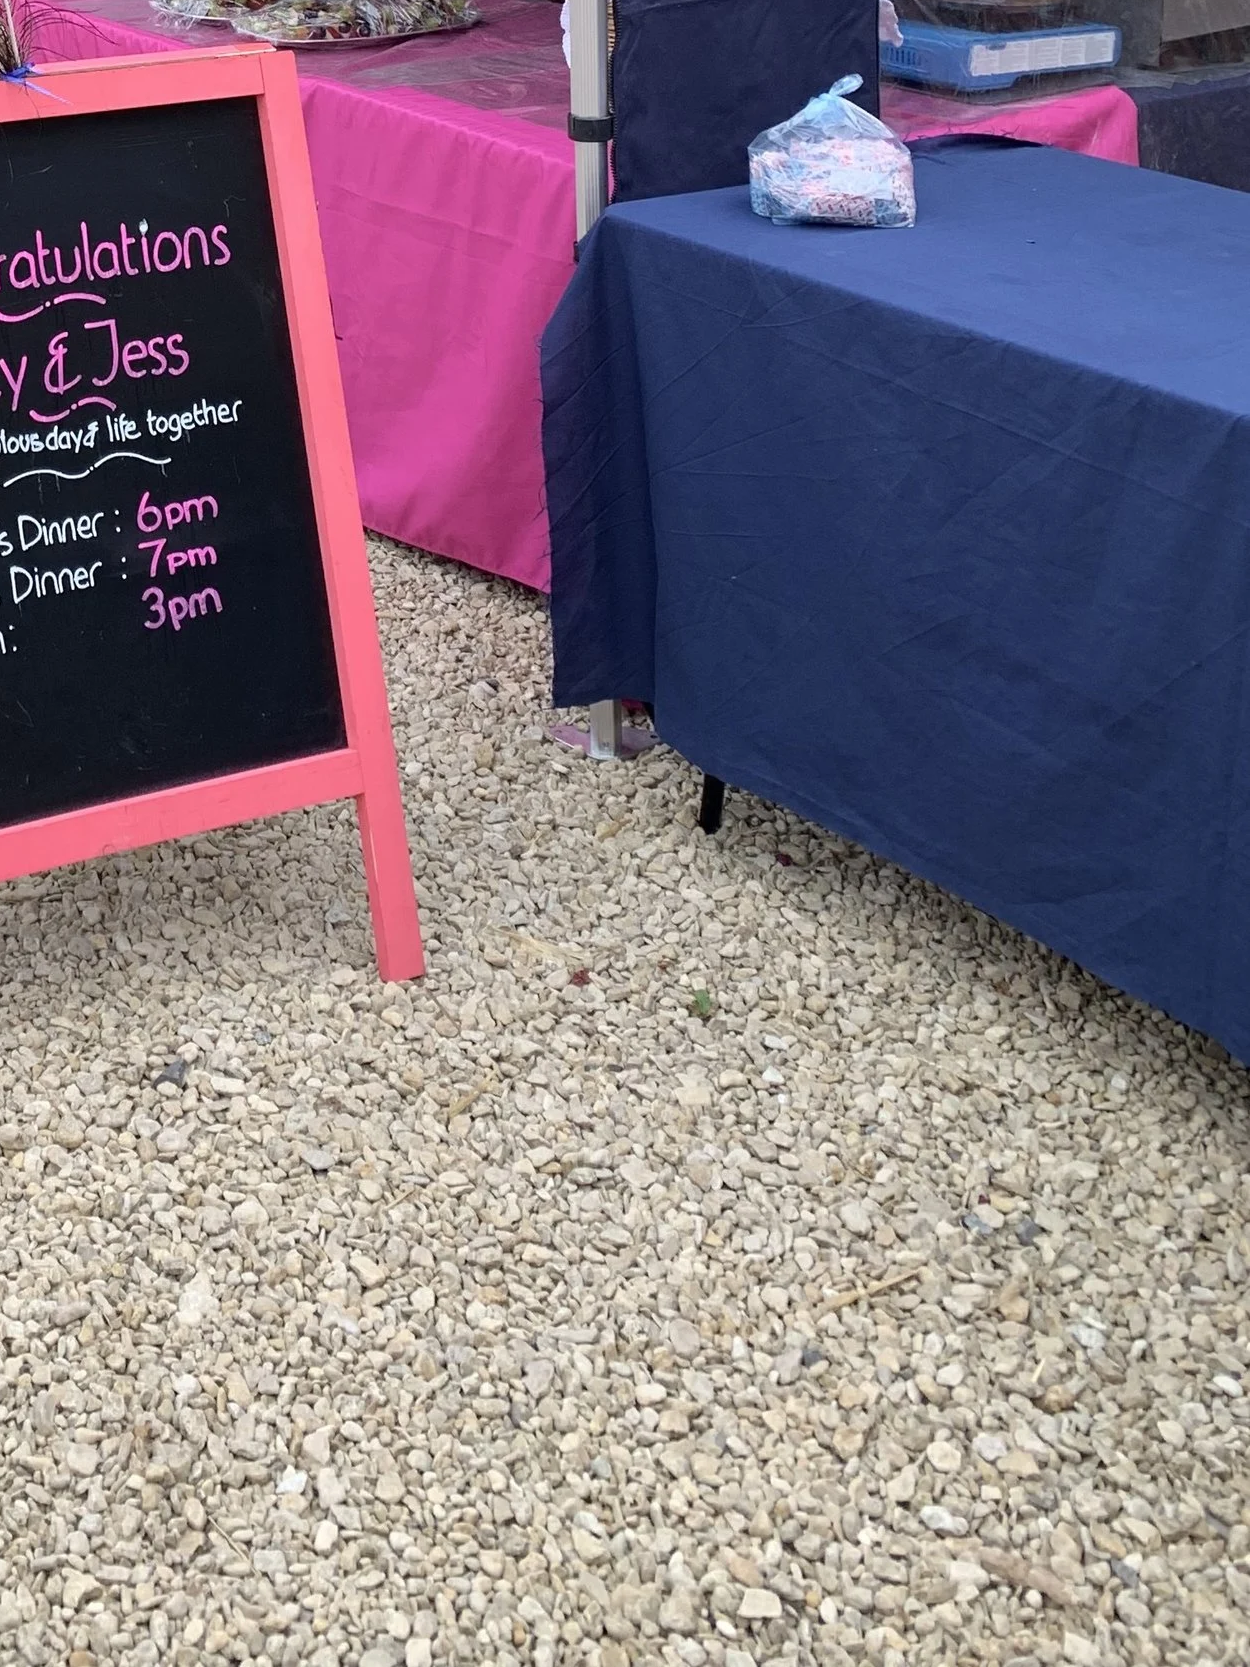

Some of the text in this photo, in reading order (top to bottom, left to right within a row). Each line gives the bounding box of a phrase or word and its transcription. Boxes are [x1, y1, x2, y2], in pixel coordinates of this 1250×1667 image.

[44, 331, 82, 395] &
[84, 319, 190, 386] Jess
[106, 413, 141, 442] life
[146, 399, 242, 441] together
[17, 512, 104, 551] Dinner
[137, 491, 218, 532] 6pm
[10, 561, 102, 604] Dinner
[138, 538, 217, 577] 7pm
[141, 586, 223, 631] 3pm
